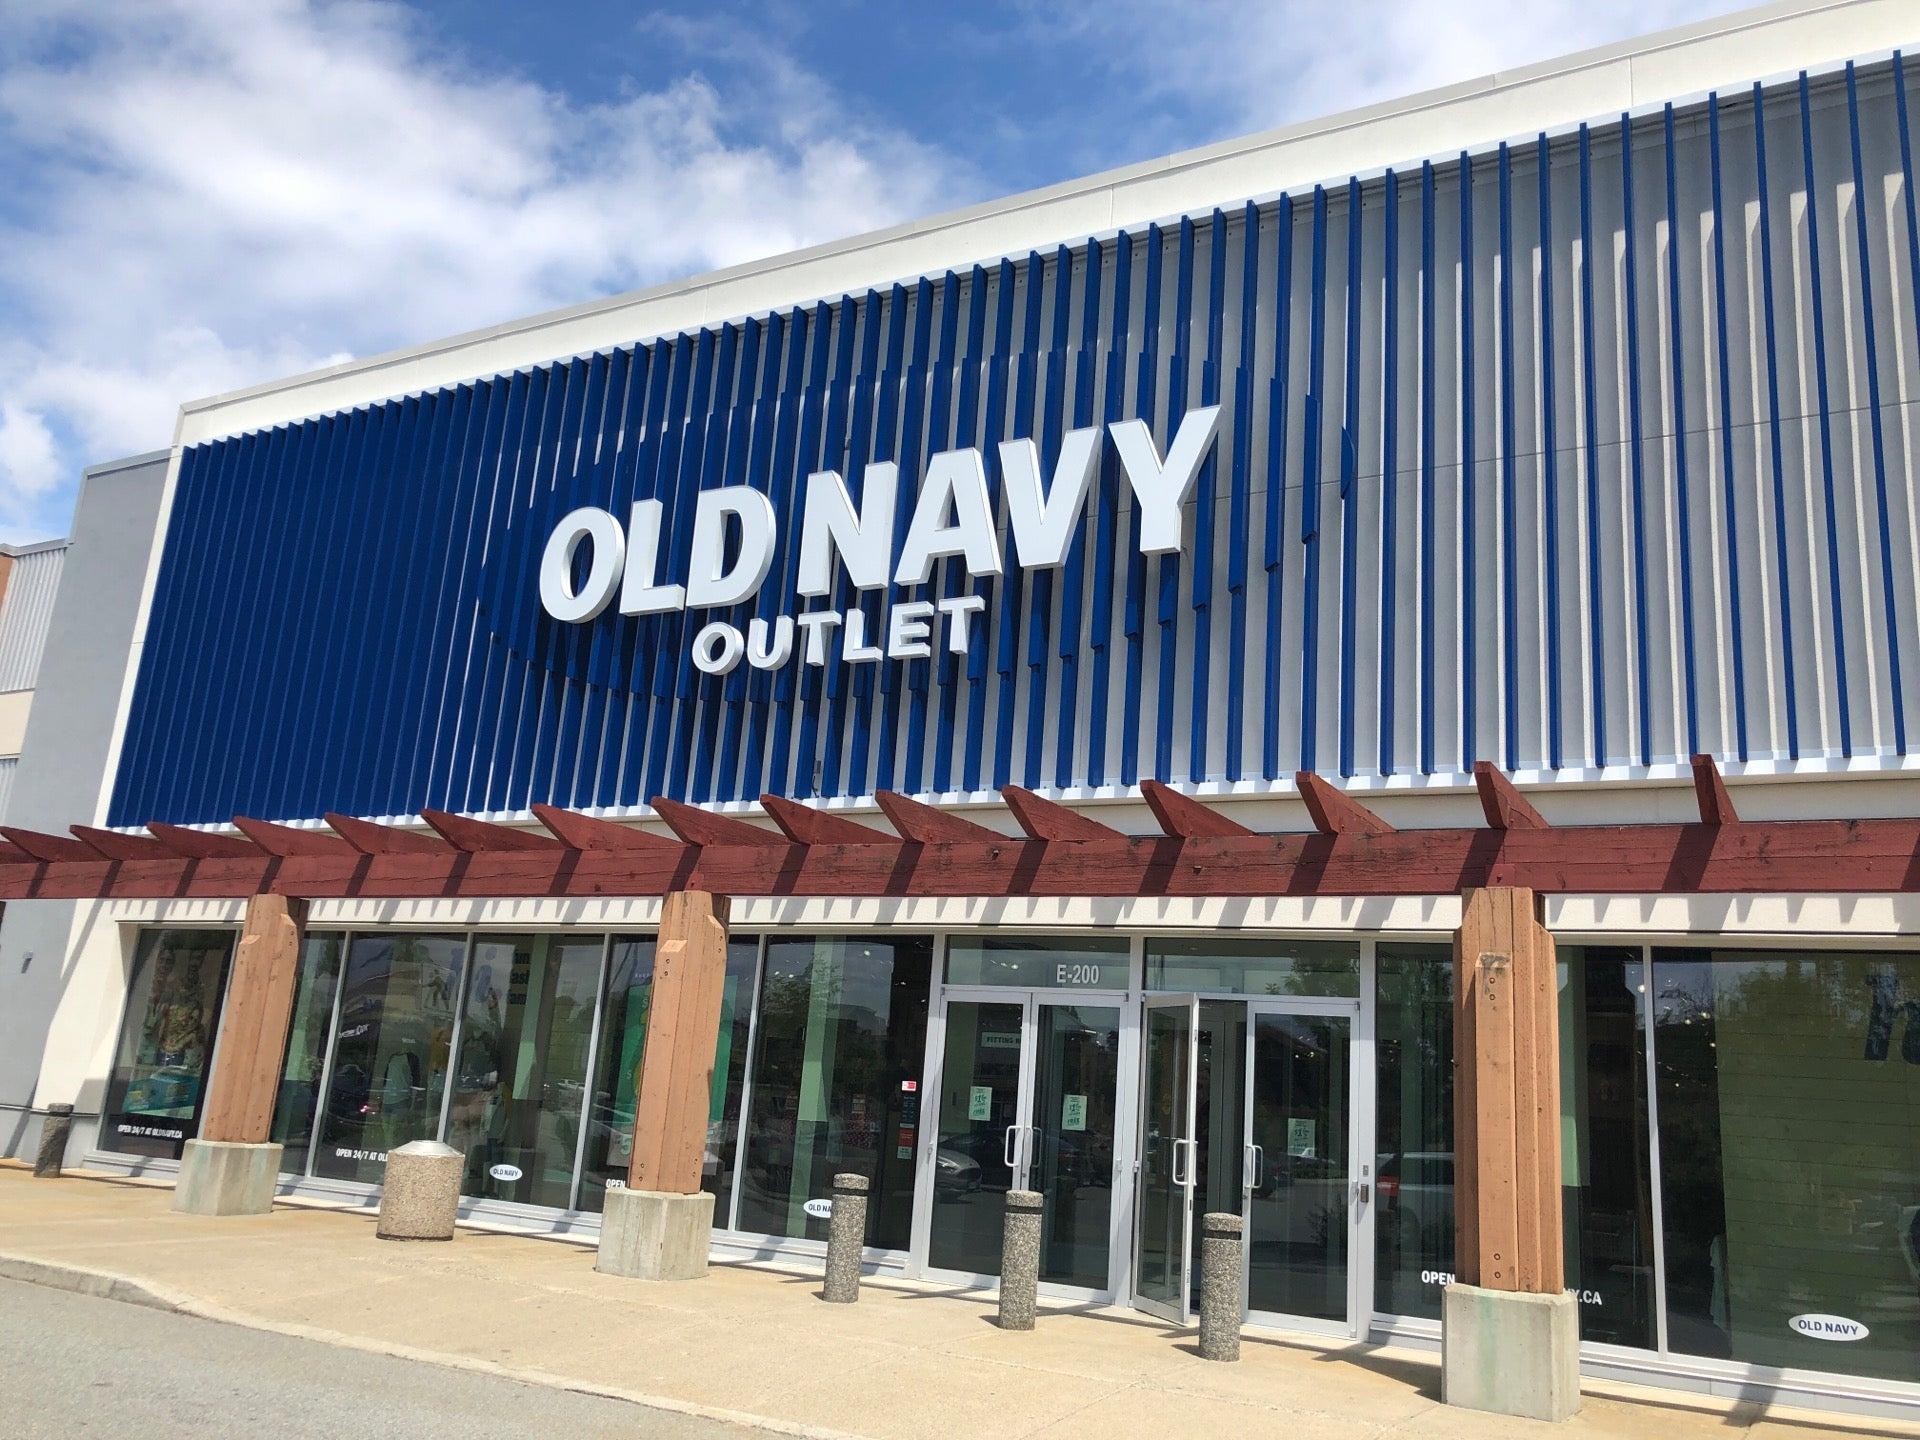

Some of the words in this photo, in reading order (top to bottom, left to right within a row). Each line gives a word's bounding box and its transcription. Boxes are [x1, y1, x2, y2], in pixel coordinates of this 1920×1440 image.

[539, 485, 777, 624] OLD
[797, 404, 1222, 597] NAVY
[692, 595, 985, 675] OUTLET
[1056, 964, 1099, 984] E-200
[336, 1148, 352, 1157] OPEN
[353, 1150, 370, 1160] 24/7
[369, 1152, 378, 1161] AT
[605, 1178, 627, 1188] OPEN
[808, 1203, 821, 1211] OLD
[822, 1204, 832, 1212] NA
[1421, 1270, 1456, 1285] OPEN
[1798, 1319, 1822, 1331] OLD
[1824, 1322, 1858, 1335] NAVY
